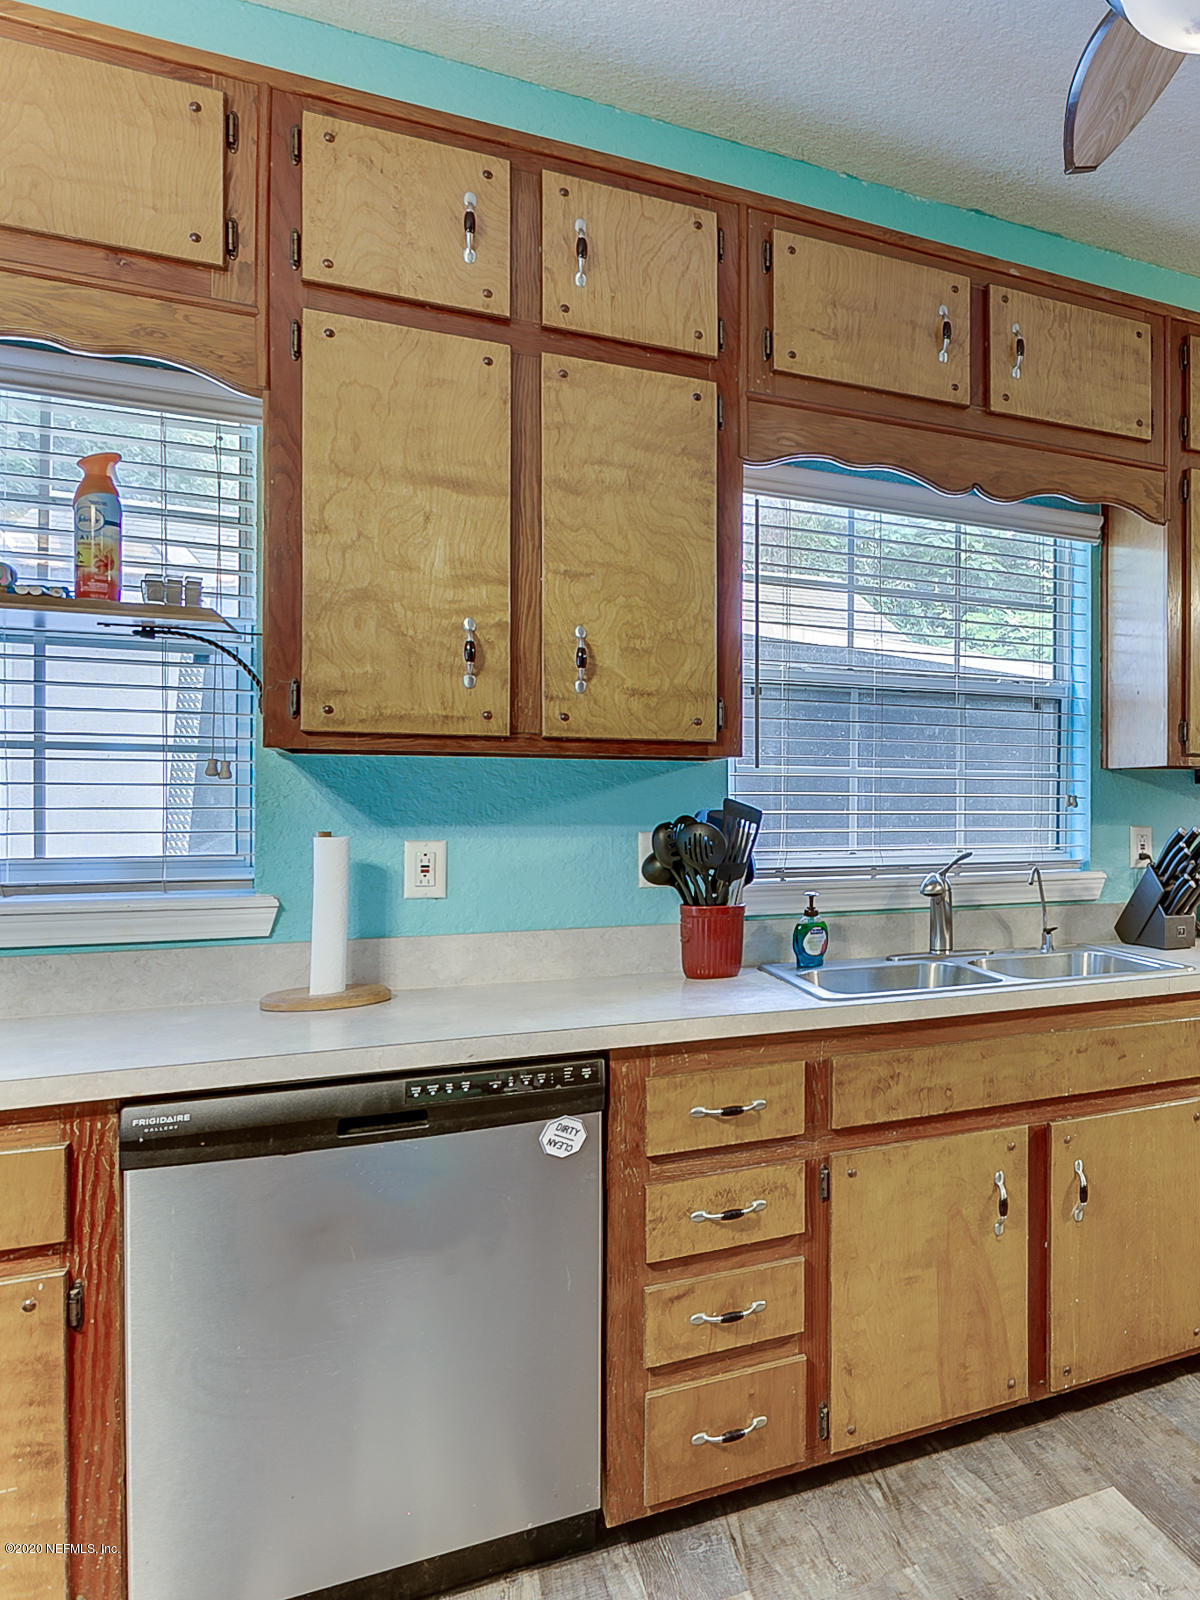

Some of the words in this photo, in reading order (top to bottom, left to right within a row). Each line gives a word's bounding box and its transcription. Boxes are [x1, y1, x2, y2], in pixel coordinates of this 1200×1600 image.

[132, 1113, 191, 1127] FRIGIDAIRE
[556, 1123, 581, 1136] DIRTY
[546, 1138, 573, 1152] CLEAN
